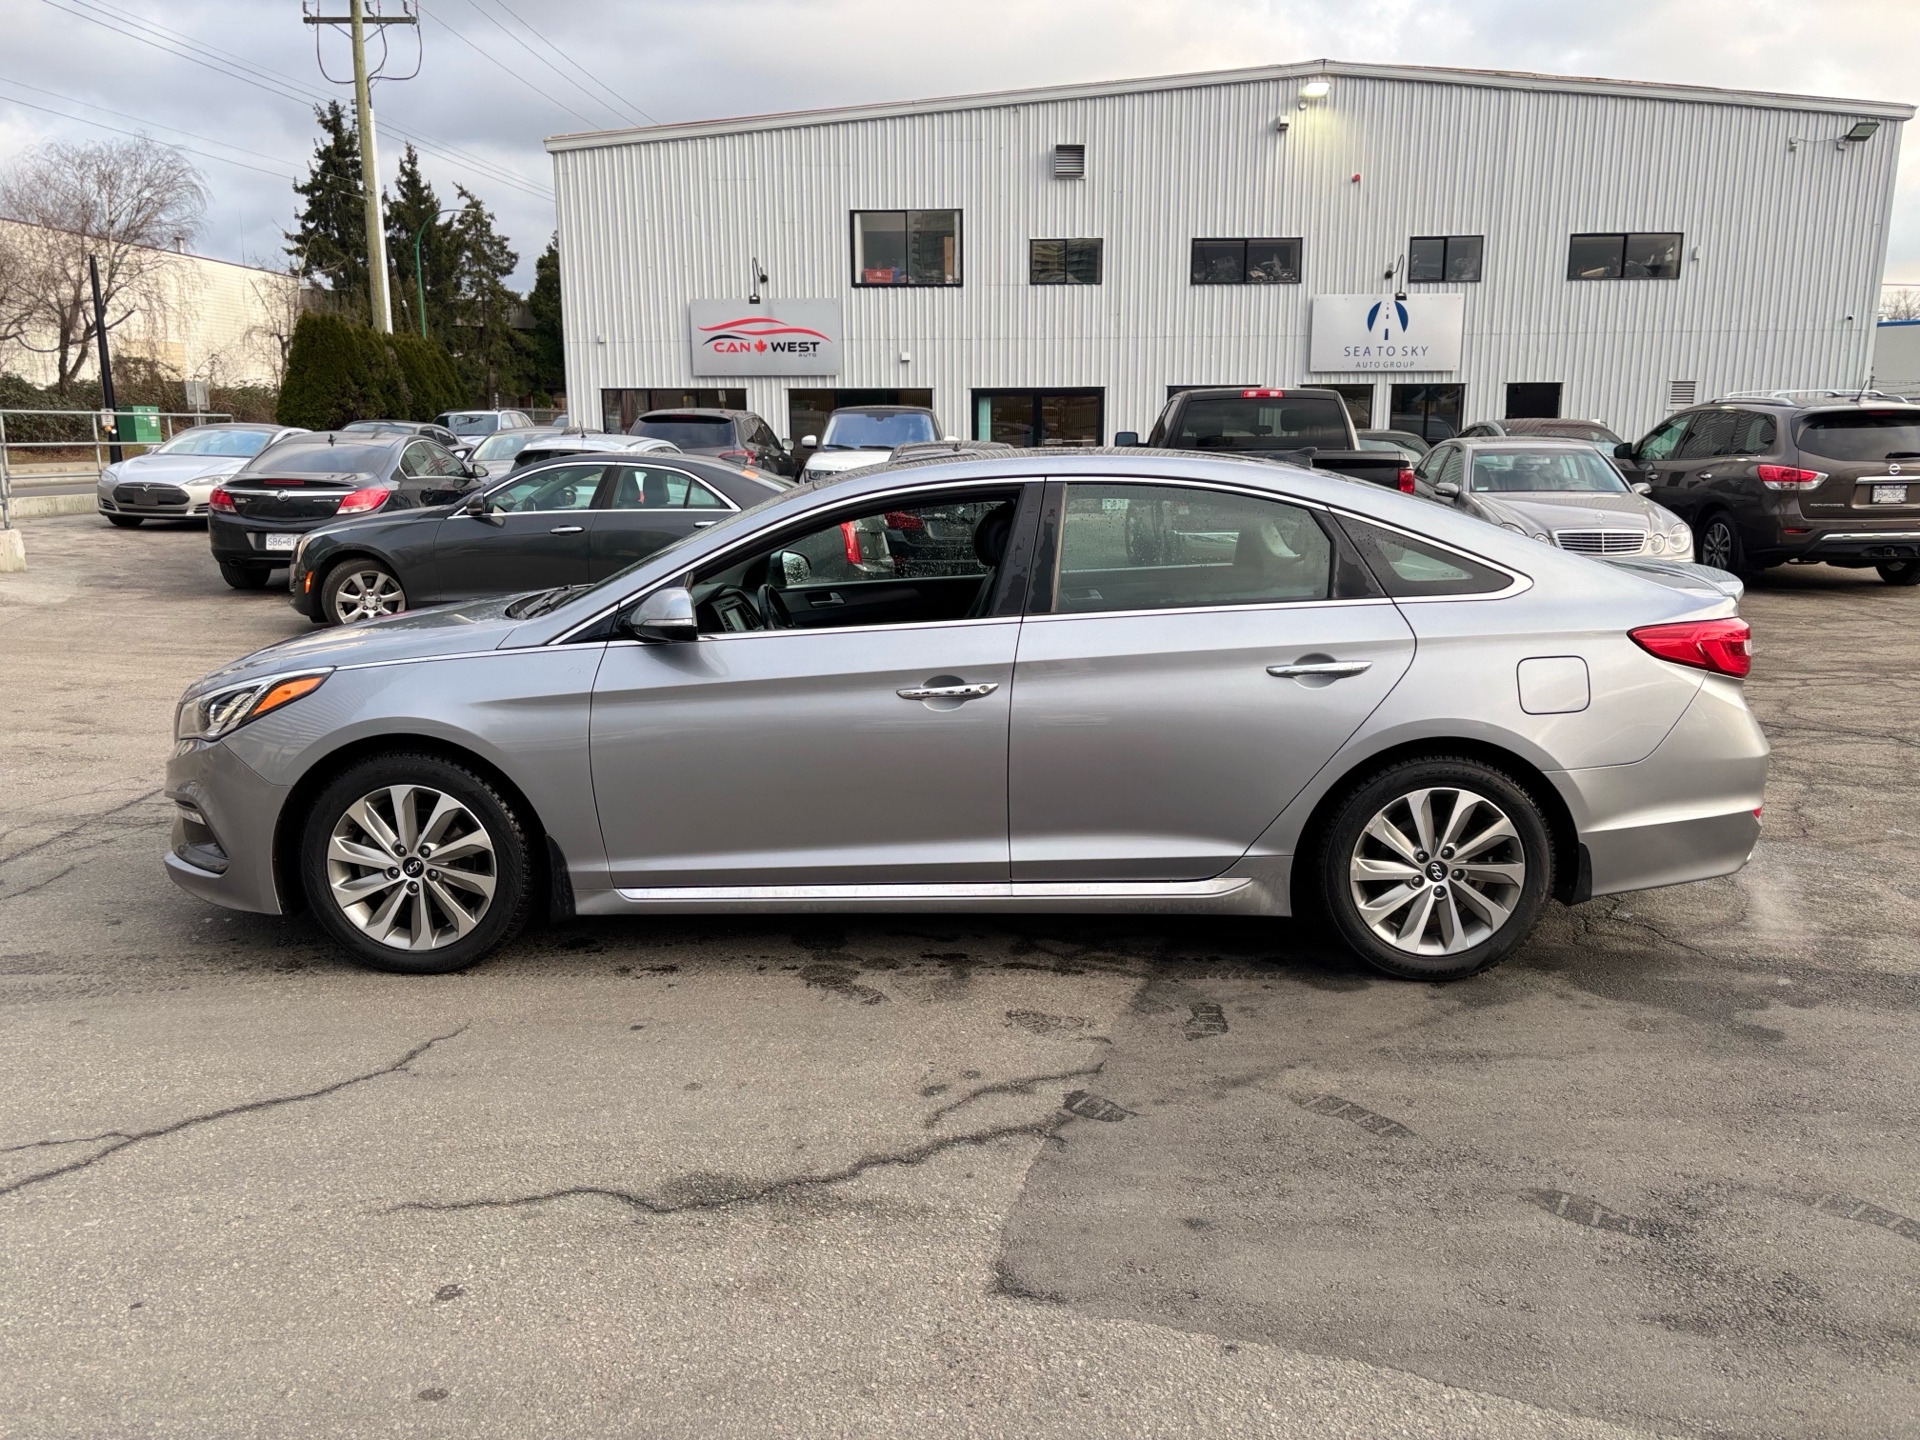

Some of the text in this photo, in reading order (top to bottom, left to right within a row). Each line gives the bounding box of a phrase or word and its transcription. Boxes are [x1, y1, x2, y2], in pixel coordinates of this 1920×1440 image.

[713, 341, 820, 353] CAN WEST
[1344, 345, 1429, 357] SEA TO SKY
[268, 537, 295, 547] SB6-81
